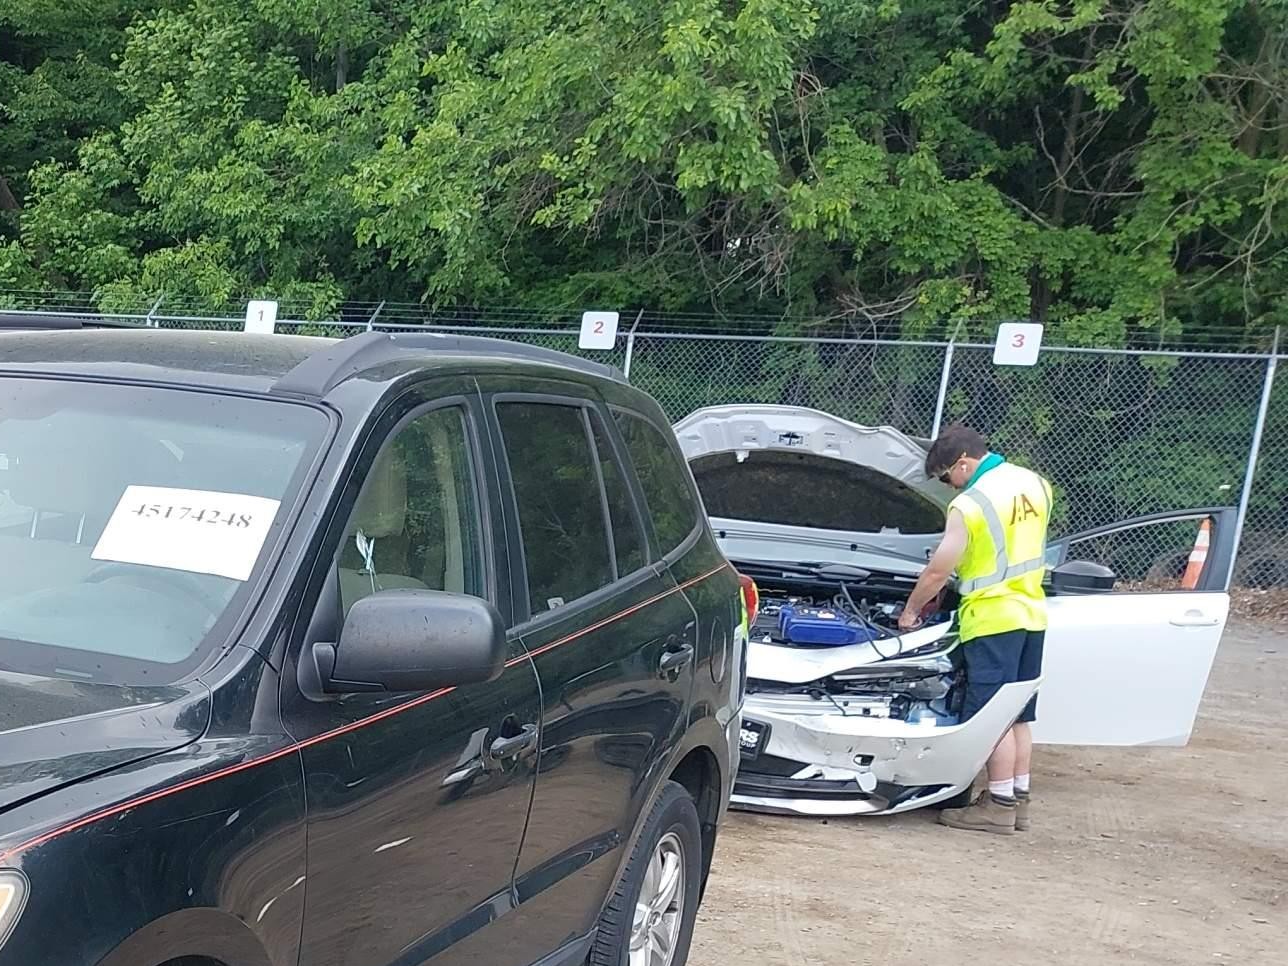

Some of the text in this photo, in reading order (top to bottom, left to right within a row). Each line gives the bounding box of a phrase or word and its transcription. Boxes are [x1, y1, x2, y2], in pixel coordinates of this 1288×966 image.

[257, 310, 264, 322] 1
[593, 320, 604, 335] 2
[1011, 333, 1025, 349] 3
[131, 503, 253, 529] 45174248
[740, 728, 760, 743] RS
